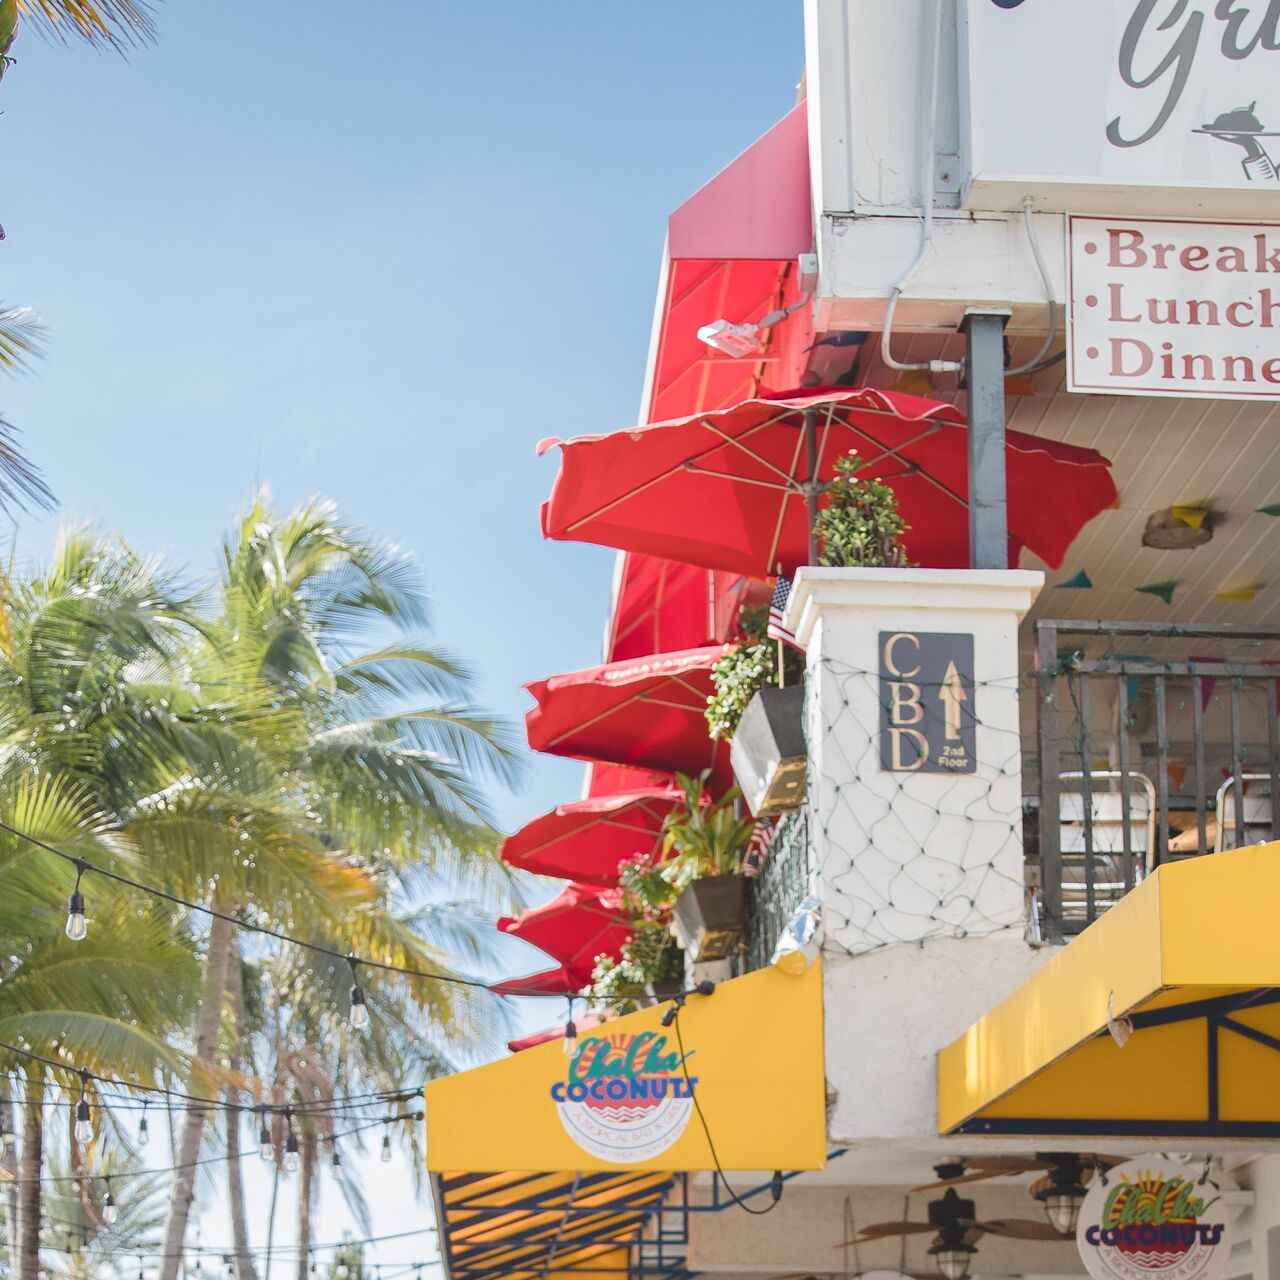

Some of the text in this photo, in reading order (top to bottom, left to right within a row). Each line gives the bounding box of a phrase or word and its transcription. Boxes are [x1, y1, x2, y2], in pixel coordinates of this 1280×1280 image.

[941, 745, 965, 757] 2nd
[938, 757, 969, 768] Floor
[550, 1077, 699, 1103] COCONUTS
[1086, 1224, 1225, 1247] COCONUTS
